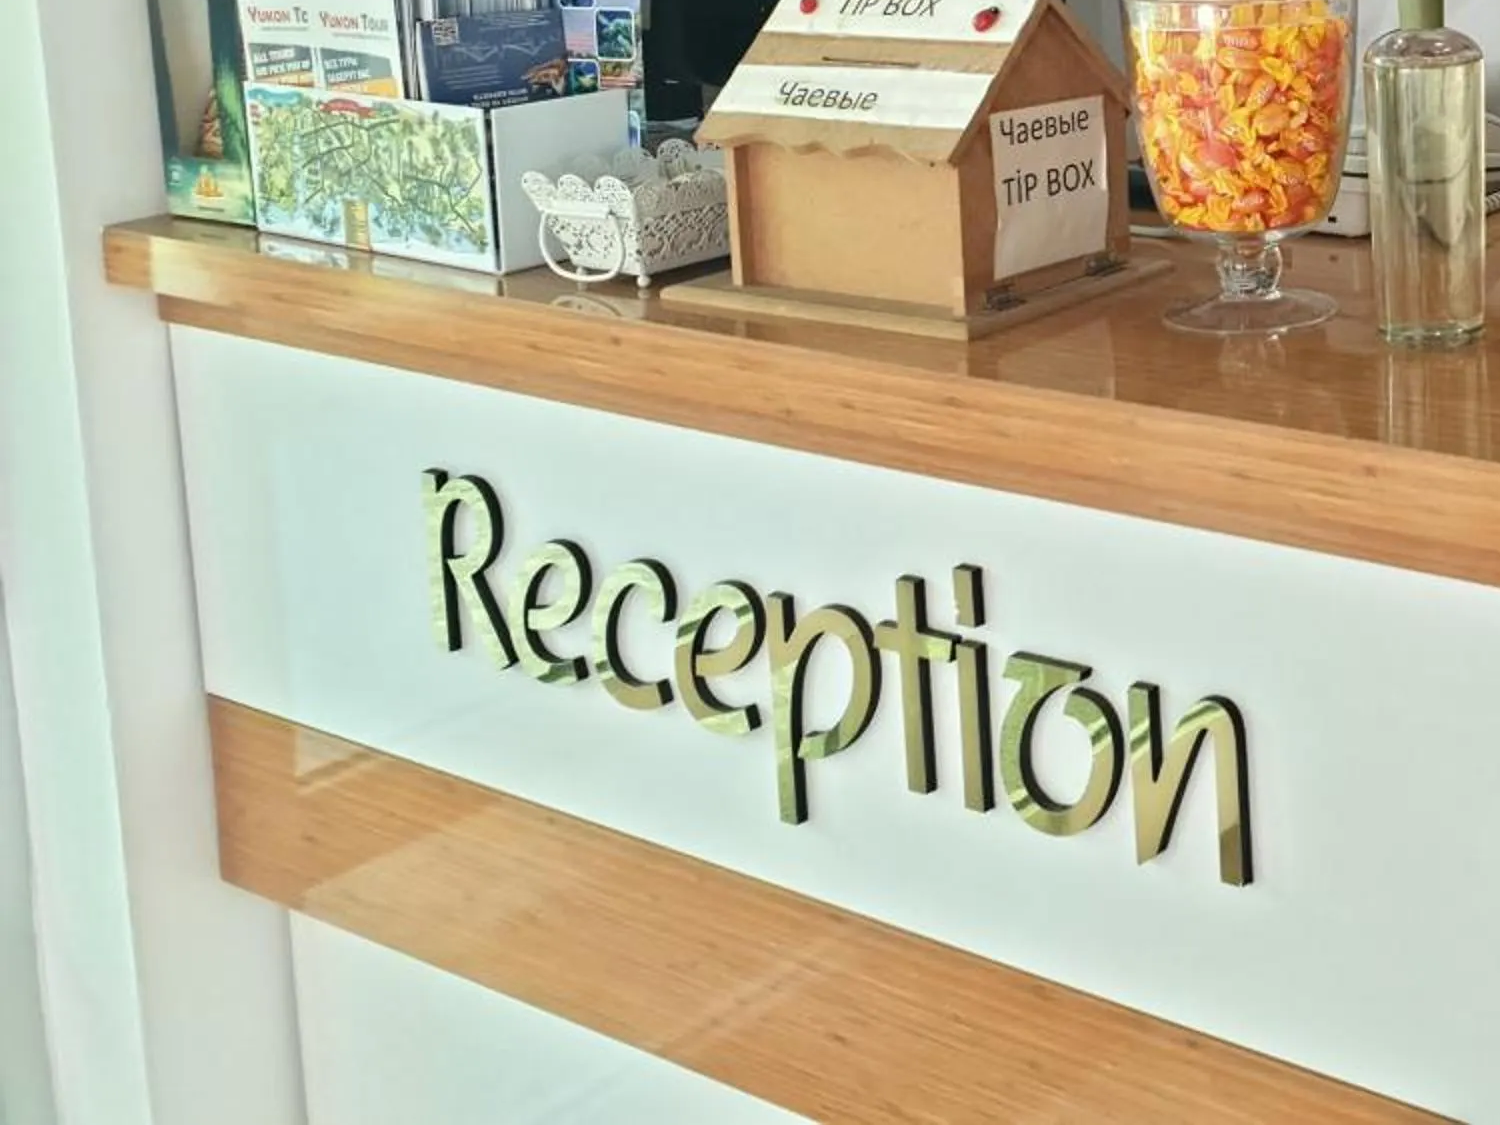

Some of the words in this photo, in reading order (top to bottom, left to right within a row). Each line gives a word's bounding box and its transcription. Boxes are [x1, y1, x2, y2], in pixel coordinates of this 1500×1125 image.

[778, 80, 879, 113] Чаевые
[999, 106, 1090, 147] Чаевые
[1045, 158, 1097, 198] BOX
[421, 468, 1253, 887] Reception
